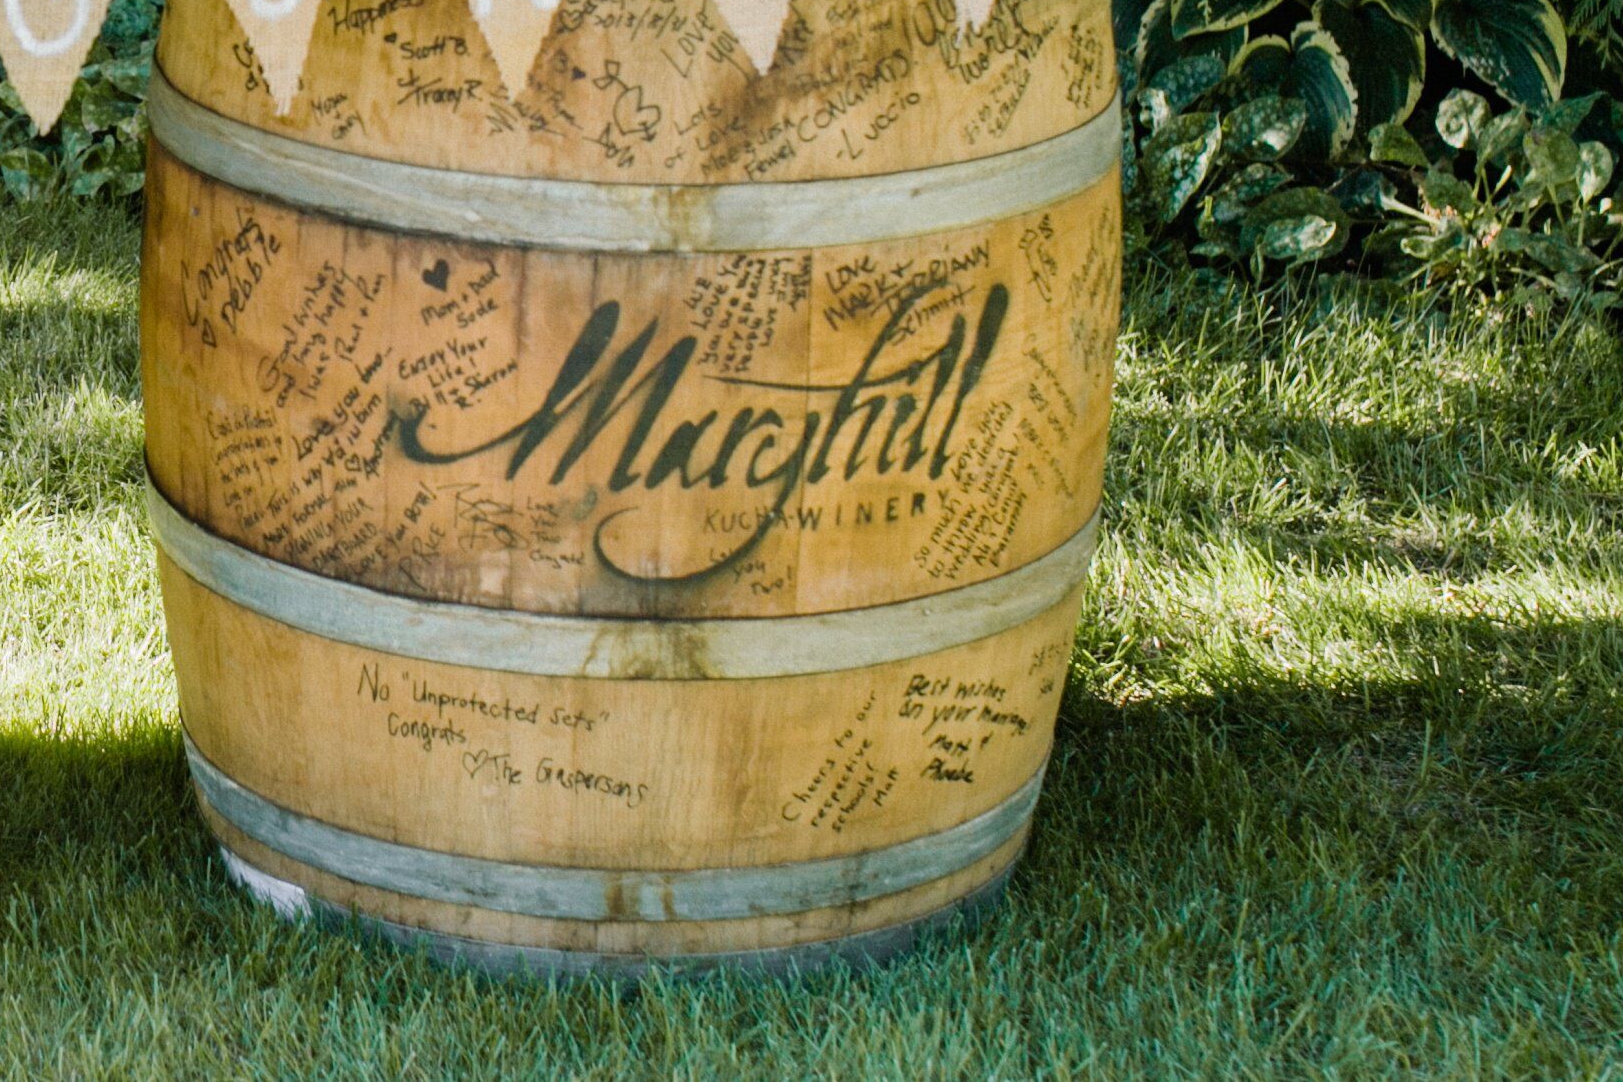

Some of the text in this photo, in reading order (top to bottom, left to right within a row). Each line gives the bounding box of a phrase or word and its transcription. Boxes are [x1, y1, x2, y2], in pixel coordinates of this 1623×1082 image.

[421, 299, 459, 326] Mom
[395, 283, 1009, 580] Maryhill
[797, 488, 950, 532] WINERY
[357, 662, 390, 703] No
[387, 712, 467, 753] Congrats
[488, 754, 522, 785] The
